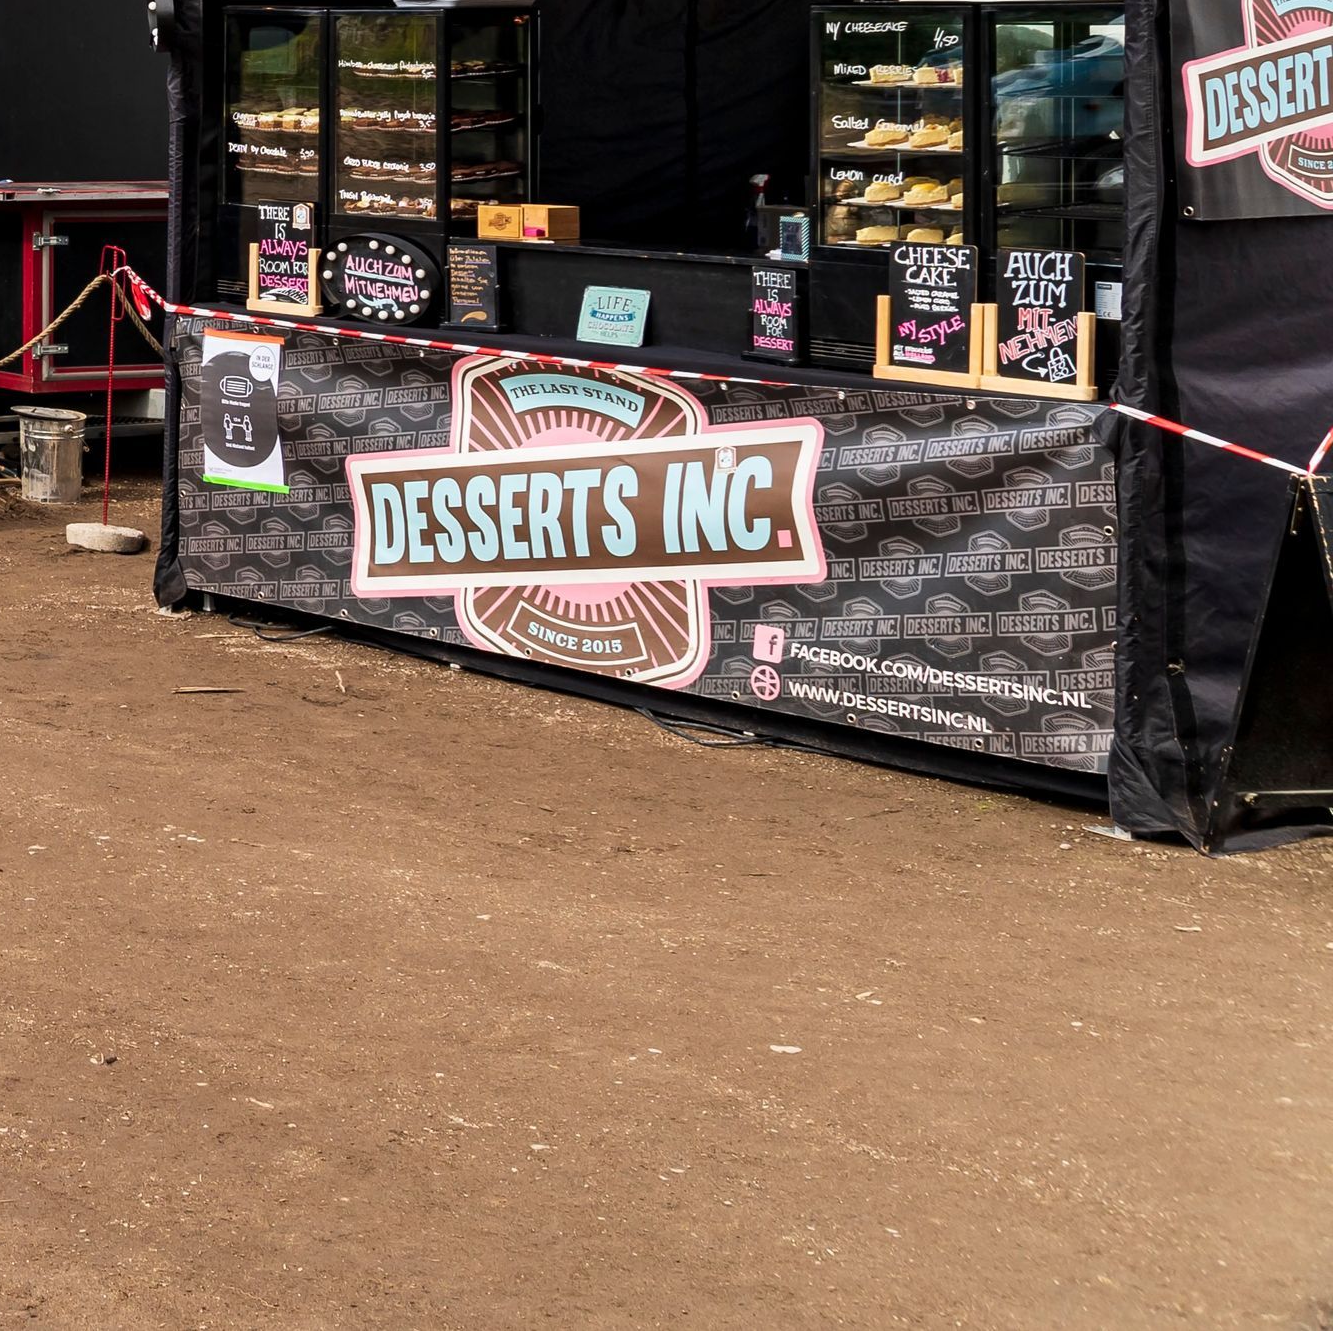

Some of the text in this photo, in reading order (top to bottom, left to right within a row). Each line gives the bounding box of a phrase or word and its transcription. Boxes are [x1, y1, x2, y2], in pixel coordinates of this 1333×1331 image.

[826, 21, 909, 41] NY CHEESECAKE
[933, 27, 959, 48] 4,50
[1205, 45, 1333, 142] DESSERT
[832, 115, 925, 132] Salted Caramel
[1297, 156, 1325, 169] SINCE
[258, 205, 290, 221] THERE
[275, 223, 286, 240] IS
[259, 240, 308, 262] ALWAYS
[894, 246, 970, 270] CHEESE
[259, 258, 309, 275] ROOM FOR
[346, 255, 413, 281] AUCH ZUM
[1003, 252, 1073, 281] AUCH
[259, 275, 309, 292] DESSERT
[753, 271, 792, 288] THERE
[906, 266, 957, 286] CAKE
[767, 289, 779, 302] IS
[1011, 280, 1067, 308] ZUM
[597, 296, 633, 312] LIFE
[754, 299, 792, 317] ALWAYS
[595, 312, 630, 321] HAPPENS
[760, 315, 788, 329] ROOM
[1017, 307, 1057, 332] MIT-
[587, 321, 635, 333] CHOCOLATE
[766, 327, 784, 338] FOR
[898, 315, 965, 345] NY STYLE
[753, 336, 794, 351] DESSERT
[999, 315, 1077, 365] NEHMEN
[251, 362, 274, 370] SCHLANGE
[510, 383, 639, 413] THE LAST STAND
[370, 454, 793, 565] DESSERTS INC.
[862, 558, 938, 576] DESSERTS INC.
[949, 554, 1028, 572] DESSERTS INC.
[907, 617, 989, 634] DESSERTS INC.
[1001, 612, 1093, 632] DESSERTS INC.
[527, 621, 623, 654] SINCE 2015
[790, 642, 1092, 709] FACEBOOK.COM/DESSERTSINC.NL
[788, 681, 993, 734] WWW.DESSERTSINC.NL
